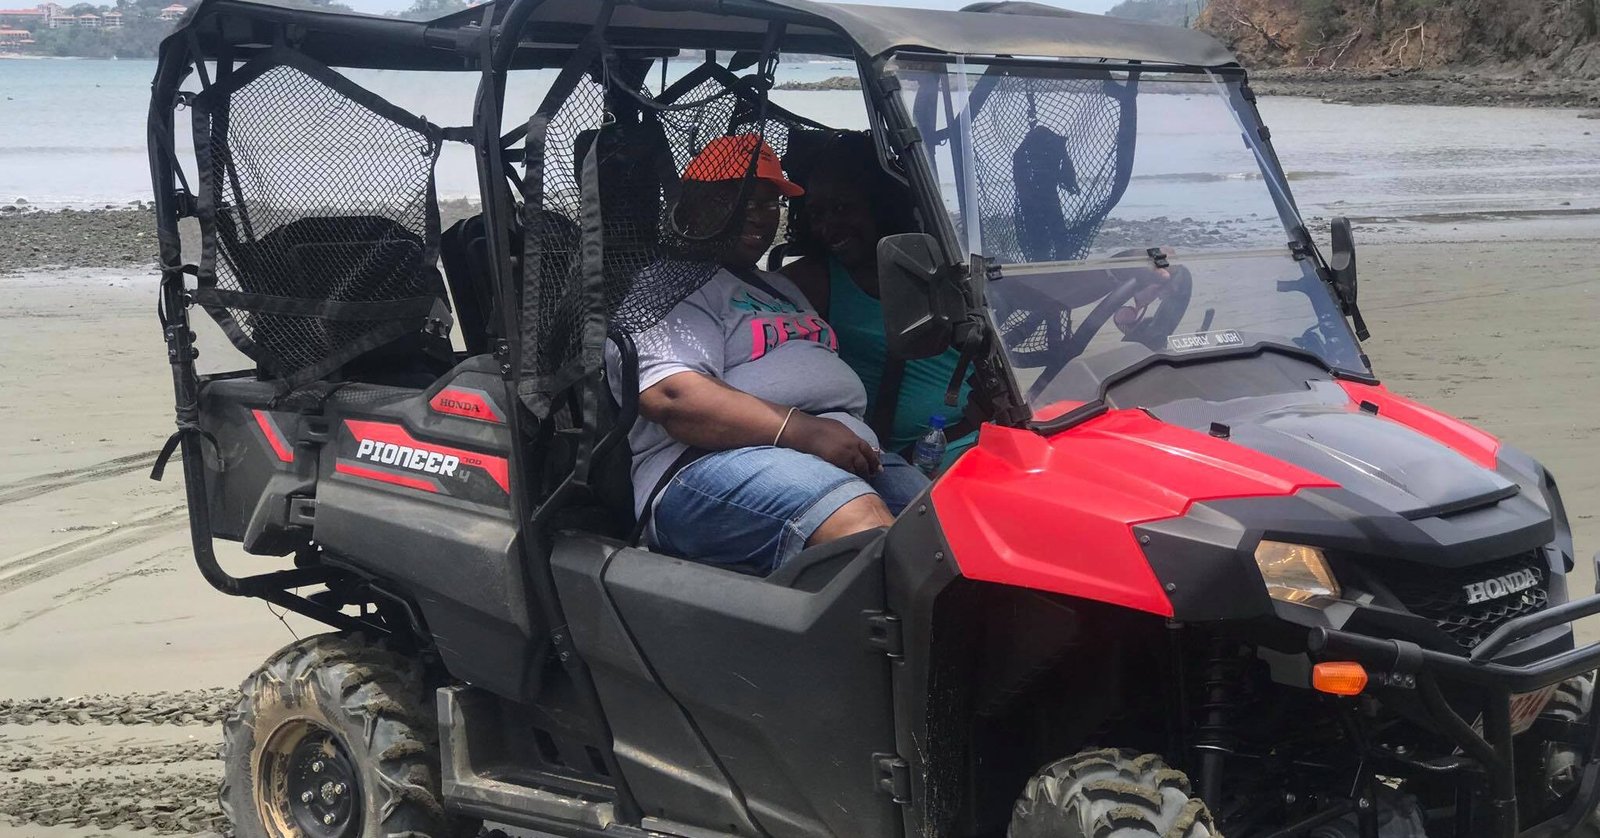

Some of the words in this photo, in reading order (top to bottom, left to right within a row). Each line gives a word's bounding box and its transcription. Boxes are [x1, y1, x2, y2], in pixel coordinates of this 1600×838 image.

[1172, 335, 1210, 349] CLEARLY
[440, 398, 481, 413] HONDA
[356, 438, 460, 477] PIONEER
[463, 457, 482, 465] 700
[1462, 567, 1539, 605] HONDA
